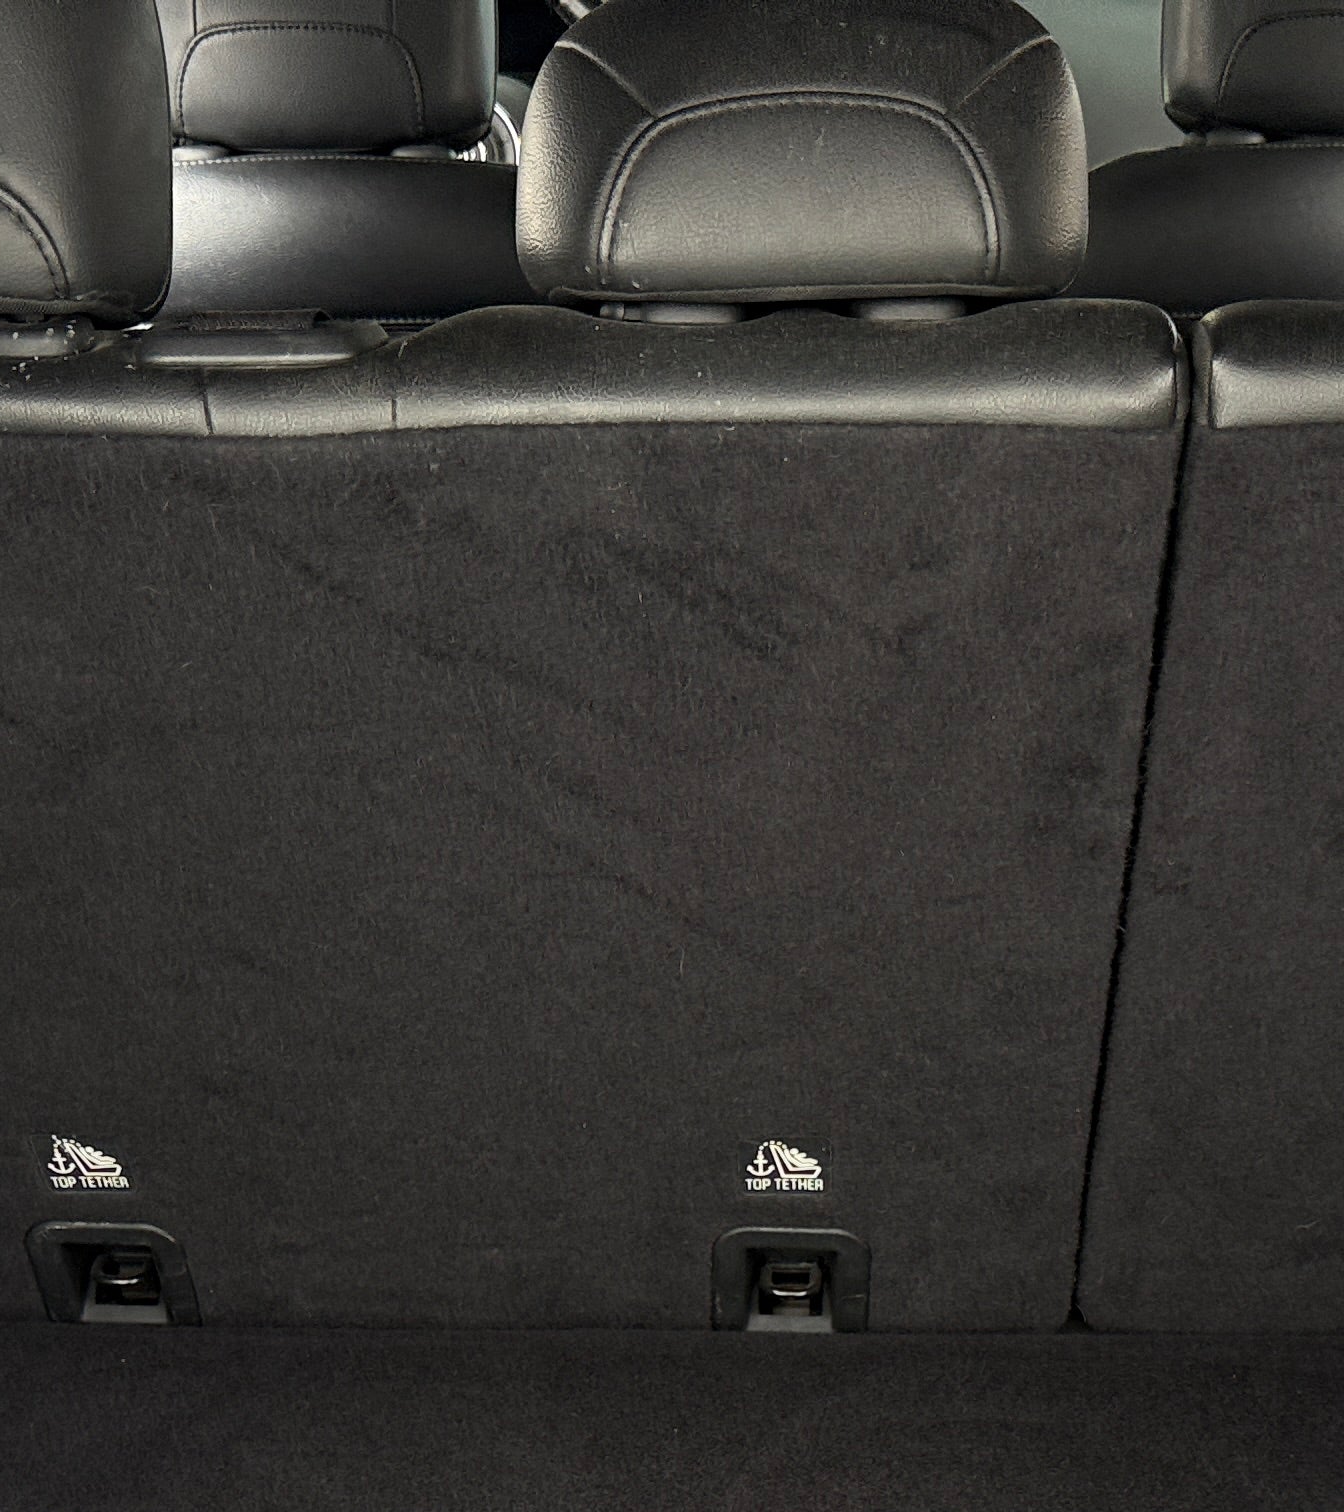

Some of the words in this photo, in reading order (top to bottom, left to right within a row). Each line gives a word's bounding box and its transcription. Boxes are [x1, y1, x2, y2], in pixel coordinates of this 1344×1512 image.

[50, 1176, 77, 1189] TOP
[79, 1176, 130, 1189] TETHER
[745, 1178, 771, 1191] TOP
[774, 1178, 824, 1191] TETHER
